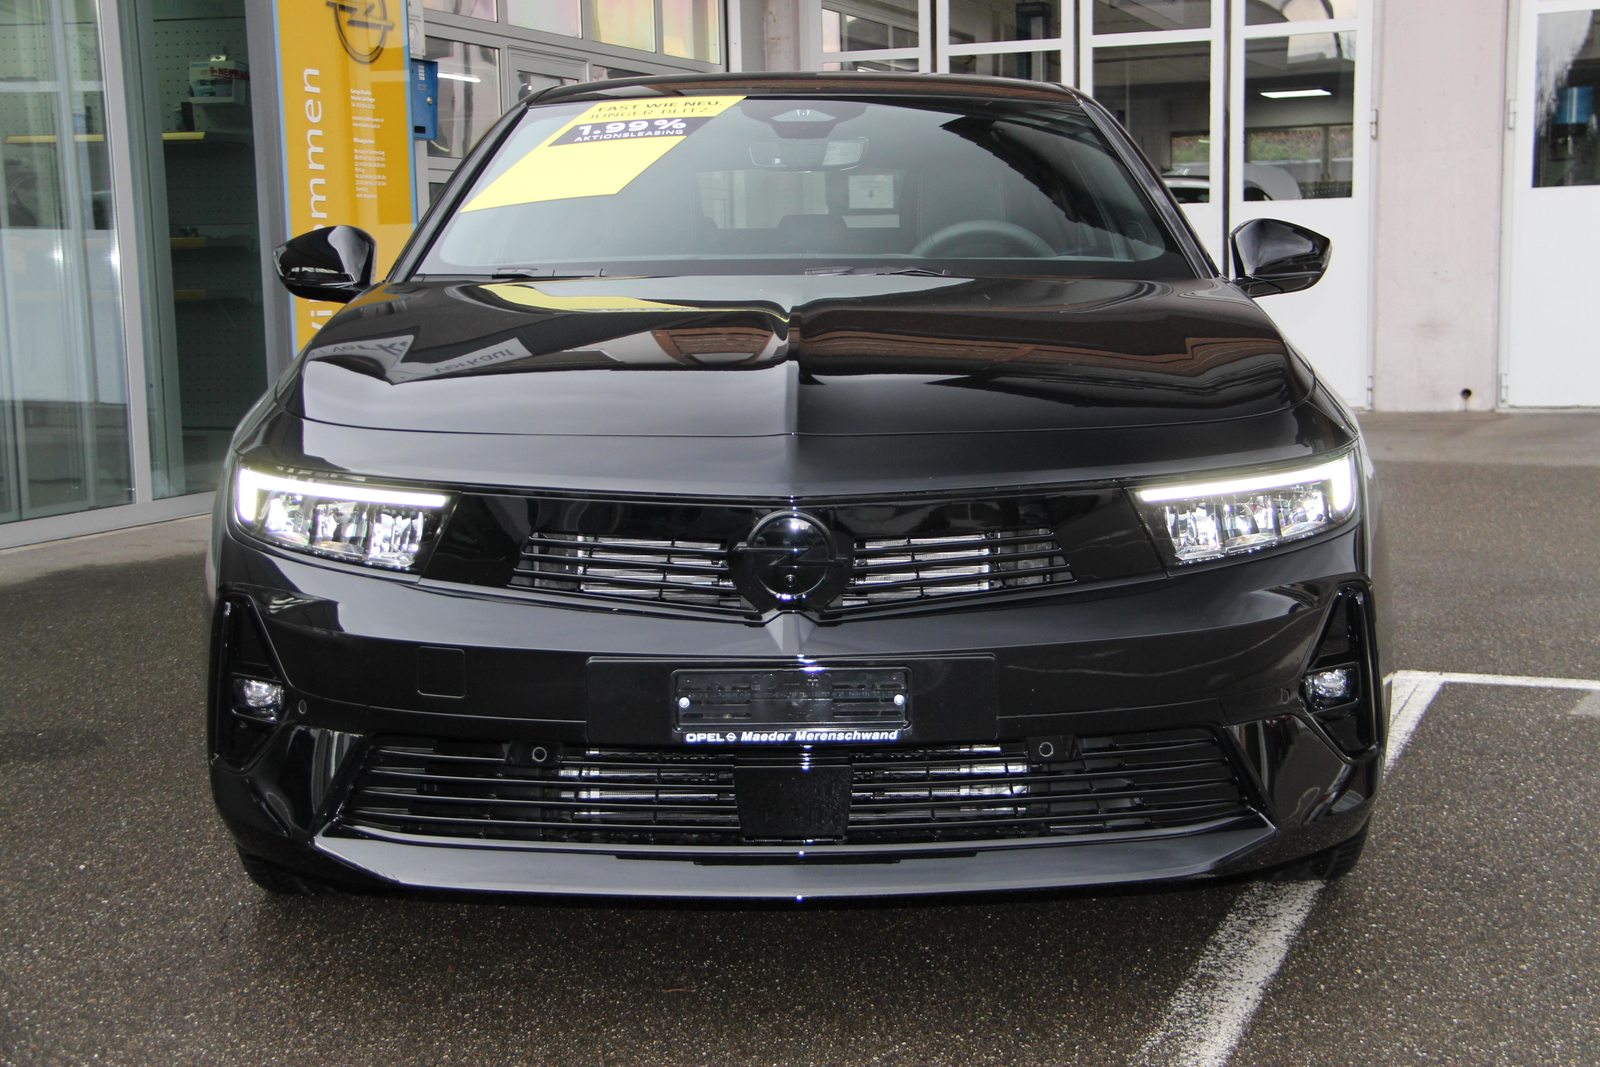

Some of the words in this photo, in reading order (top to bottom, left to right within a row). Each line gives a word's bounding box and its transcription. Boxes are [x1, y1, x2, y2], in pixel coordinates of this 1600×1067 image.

[597, 104, 641, 112] FAST
[590, 109, 655, 119] JUNGER
[574, 130, 684, 142] AKTIONSLEASING
[685, 732, 724, 742] OPEL
[740, 731, 790, 742] Maeder
[795, 729, 898, 741] Merenschwand
